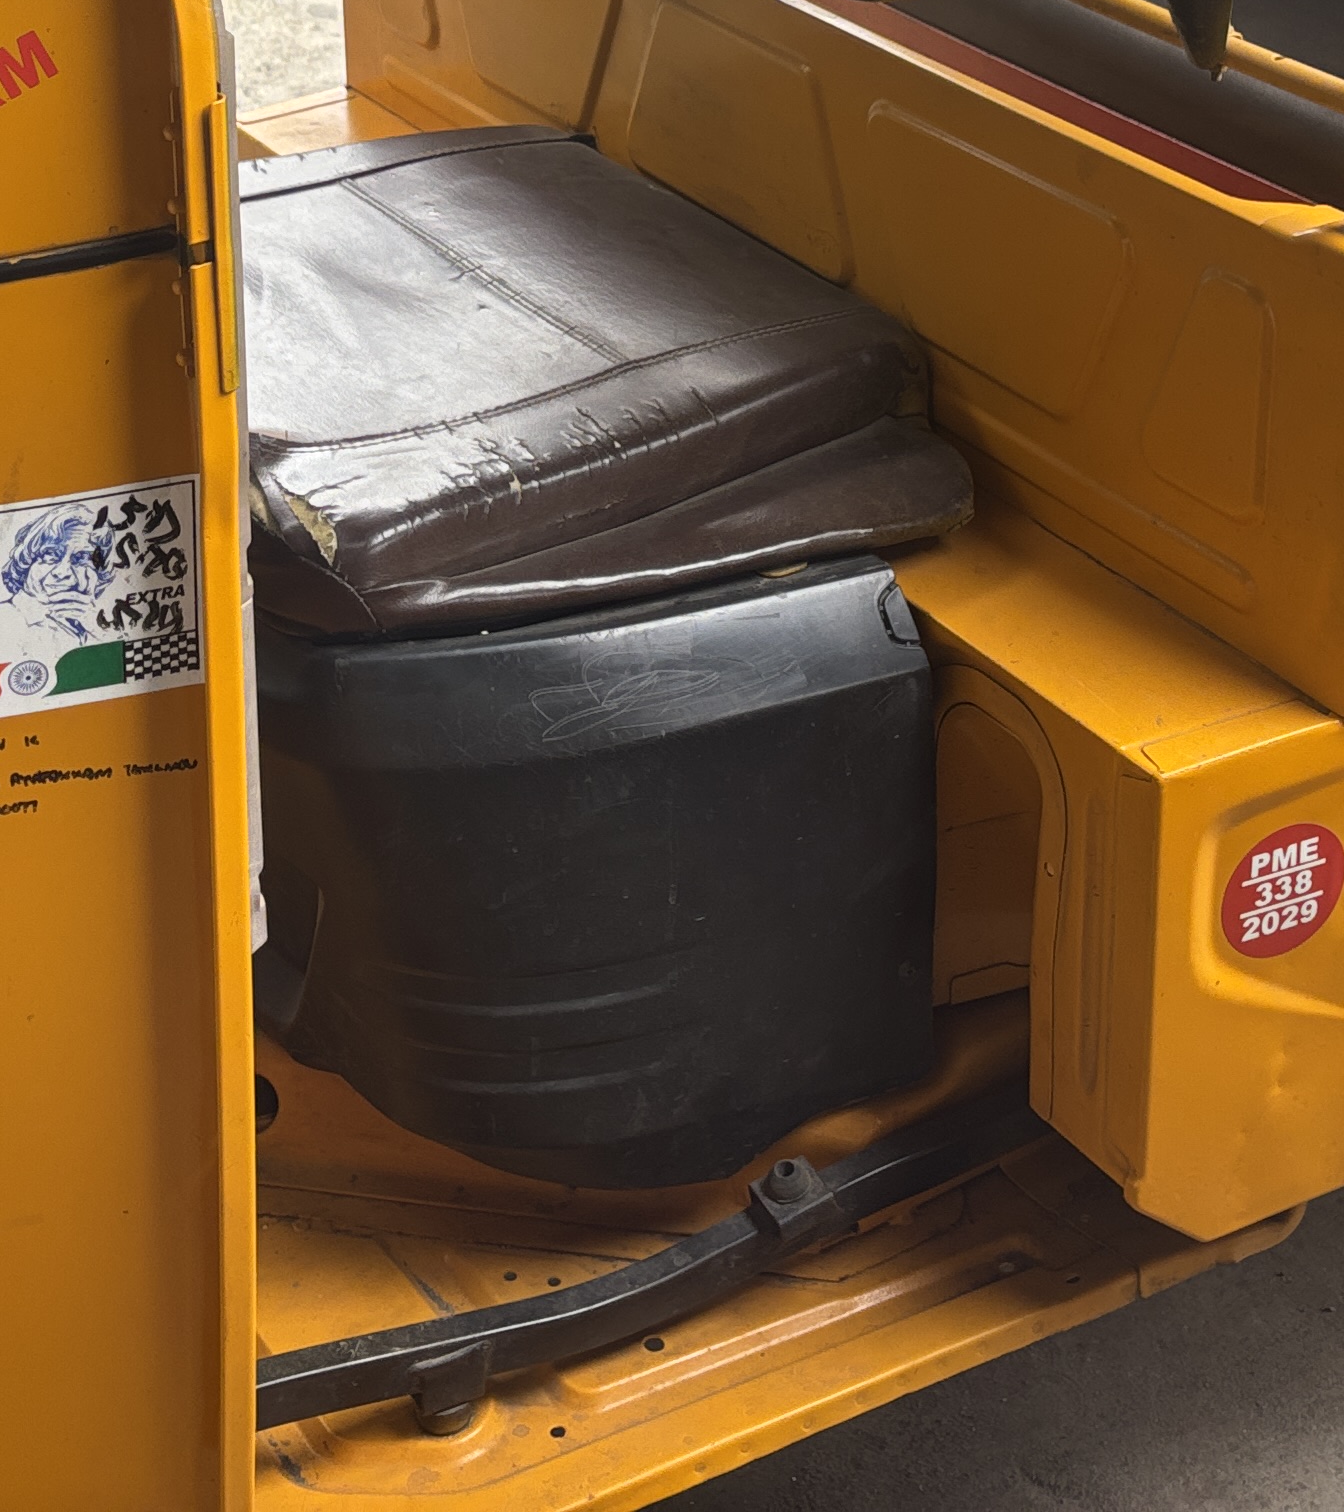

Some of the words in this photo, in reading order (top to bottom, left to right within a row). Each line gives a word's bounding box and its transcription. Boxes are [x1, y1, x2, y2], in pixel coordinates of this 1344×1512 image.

[126, 583, 186, 607] EXTRA
[1250, 836, 1320, 879] PME
[1254, 869, 1313, 908] 338
[1241, 899, 1318, 943] 2029
